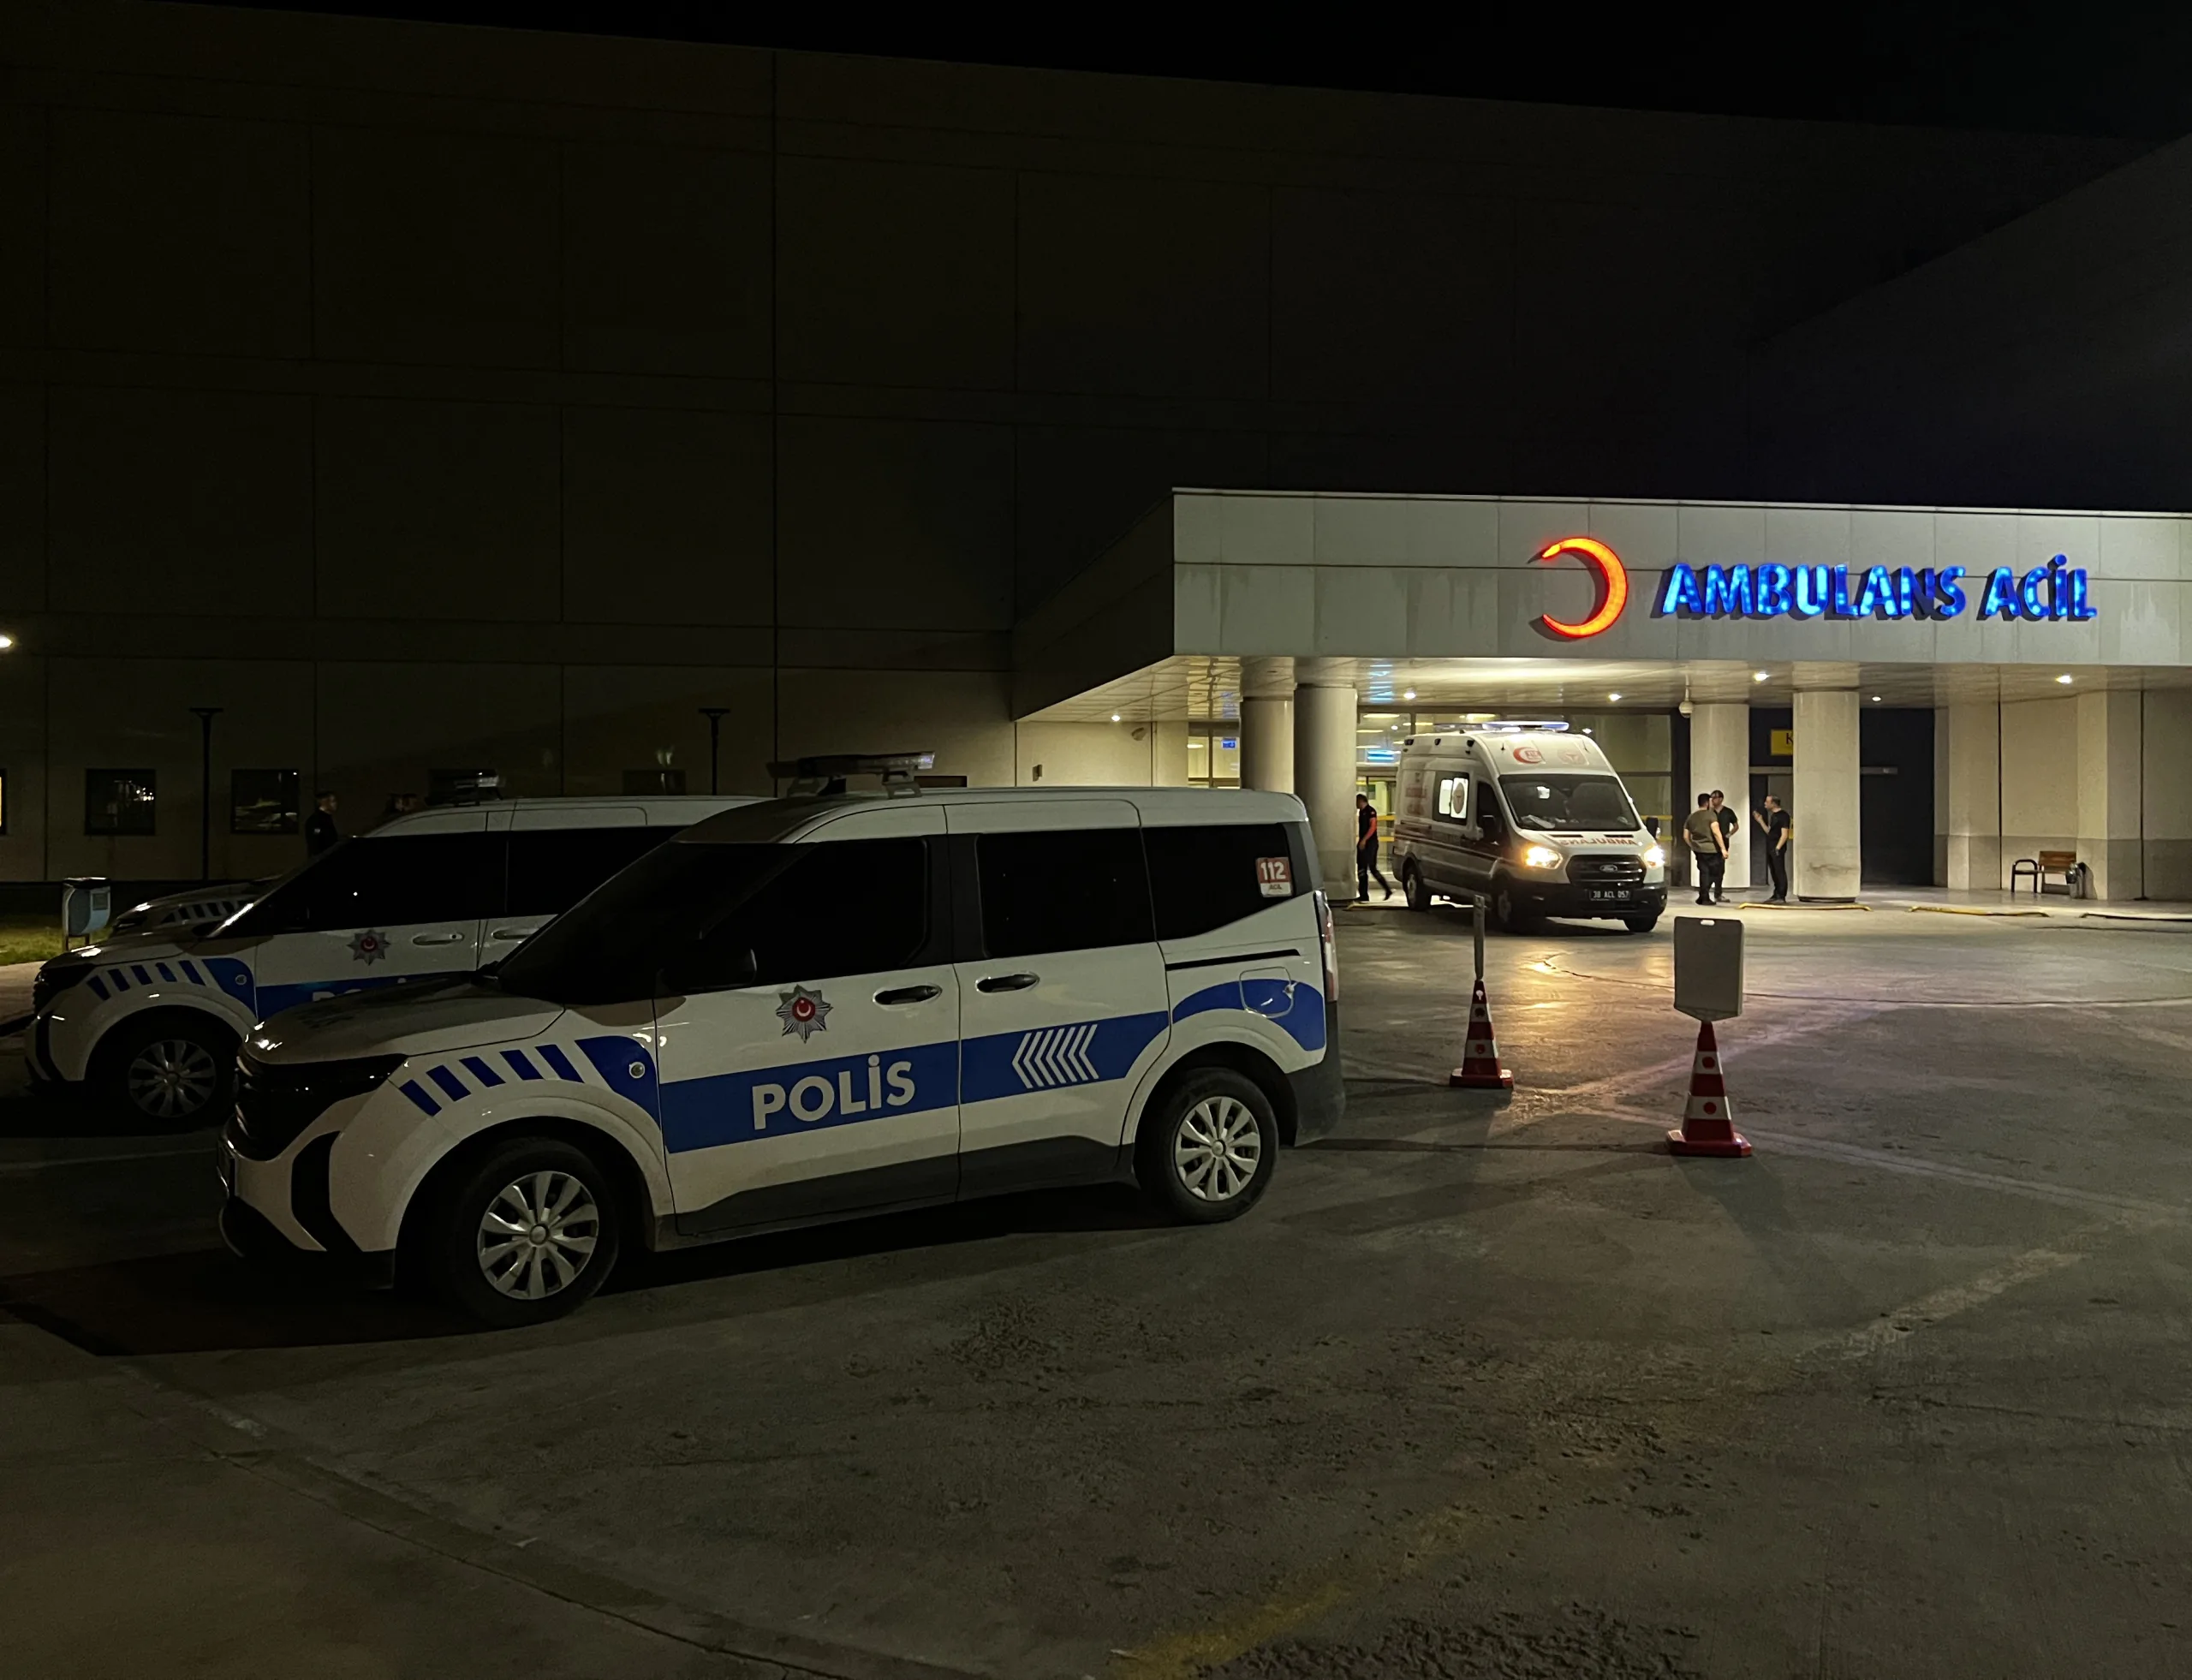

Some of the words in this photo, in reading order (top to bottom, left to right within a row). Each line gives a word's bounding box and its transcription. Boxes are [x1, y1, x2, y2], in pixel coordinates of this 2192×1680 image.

[1663, 563, 1967, 616] AMBULANS
[1985, 554, 2097, 618] ACİL
[1260, 861, 1286, 880] 112
[753, 1054, 916, 1130] POLİS
